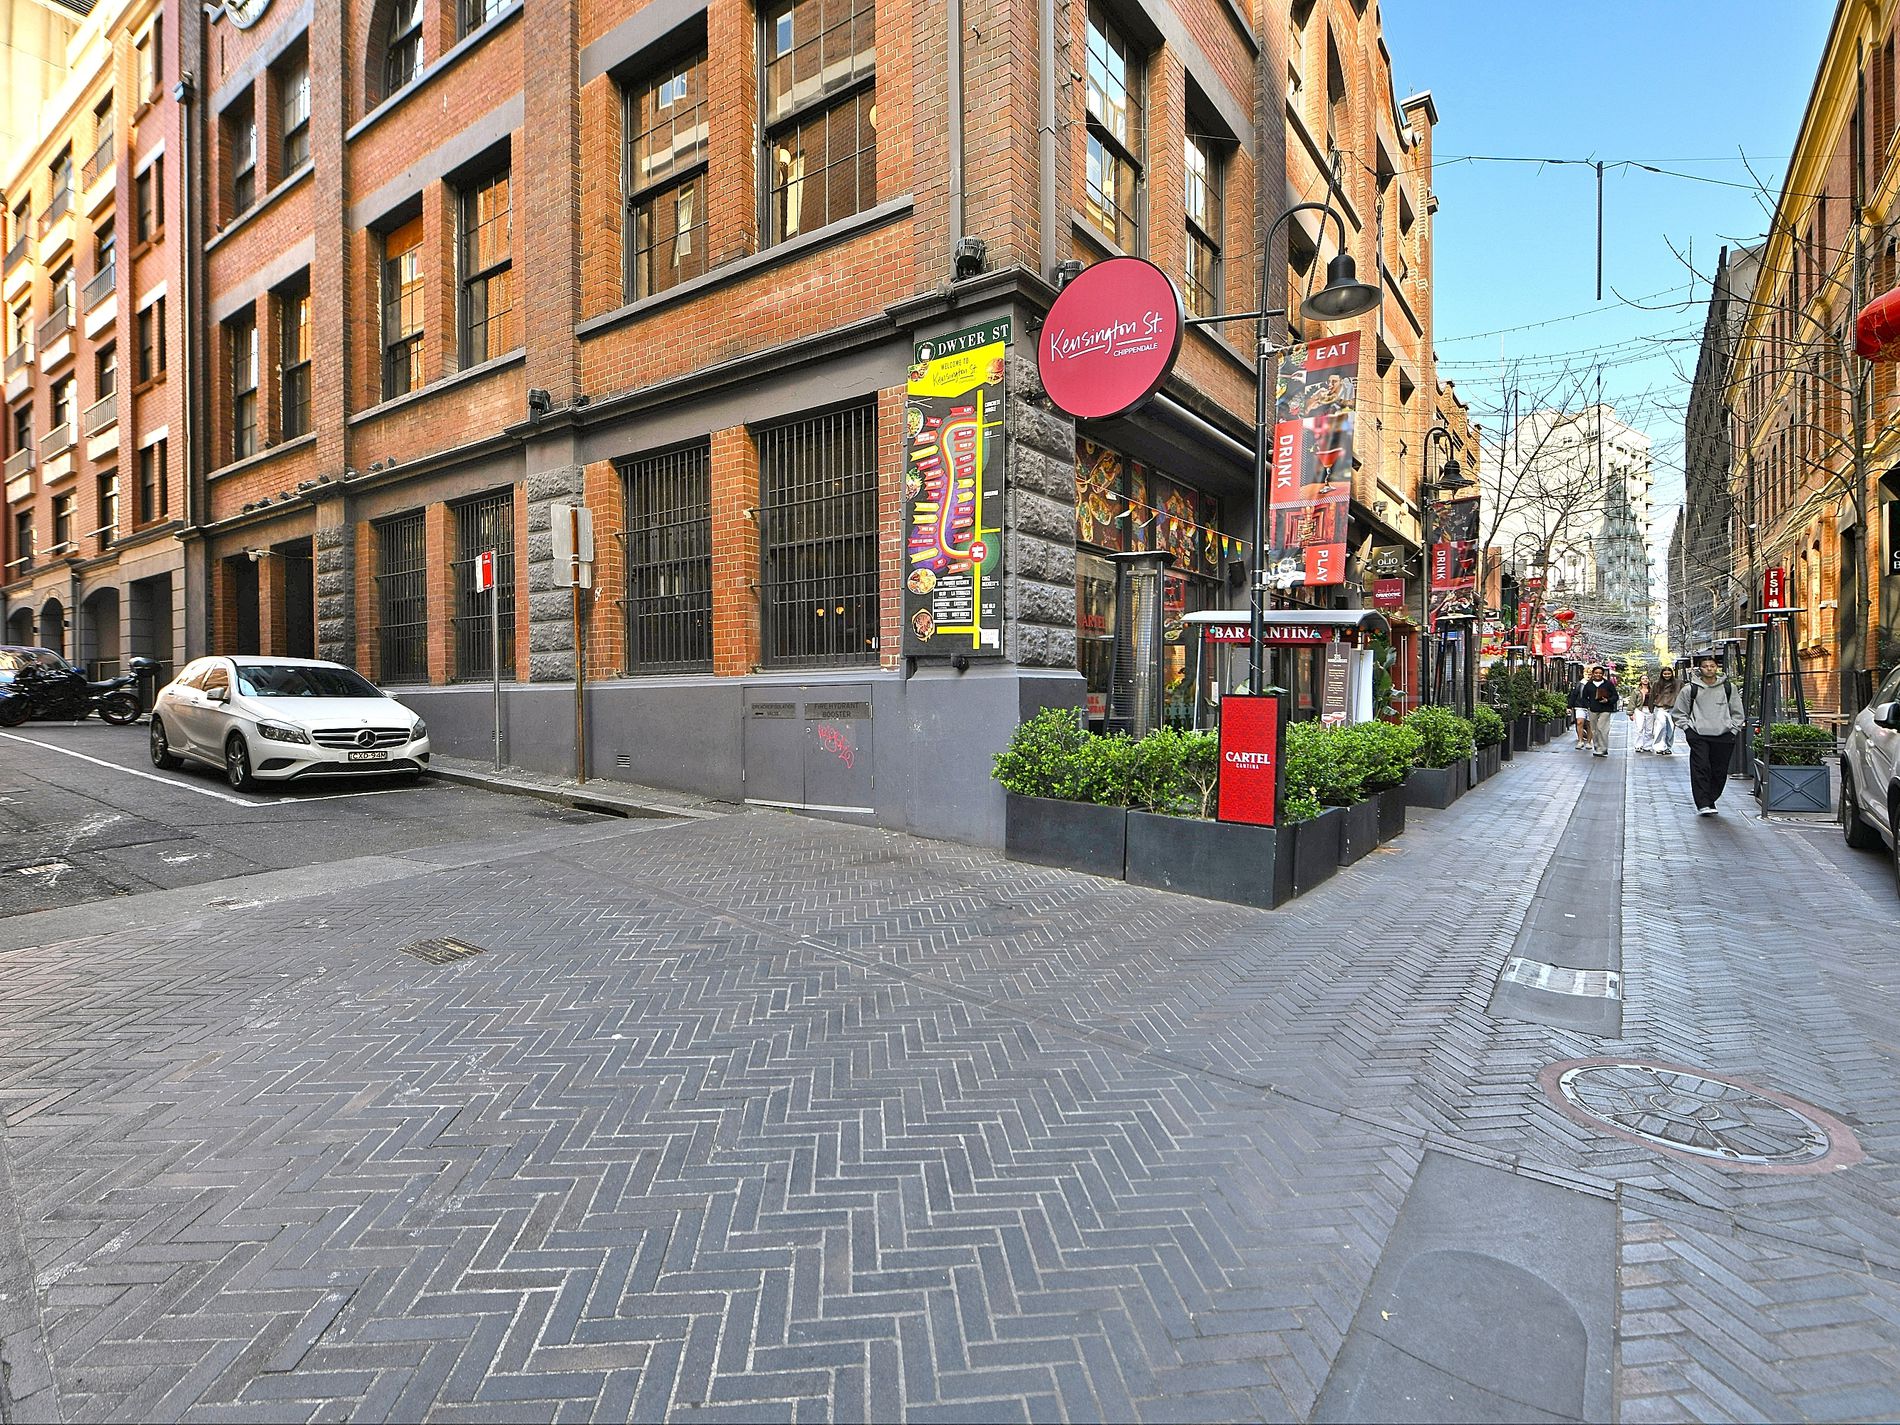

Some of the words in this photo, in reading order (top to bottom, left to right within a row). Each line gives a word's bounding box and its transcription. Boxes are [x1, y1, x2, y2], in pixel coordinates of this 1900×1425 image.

[938, 331, 986, 356] DWYER
[992, 323, 1009, 340] ST
[1050, 319, 1137, 362] Kensington
[1143, 311, 1164, 335] St.
[1113, 342, 1159, 357] CHIPPENDALE
[1316, 342, 1350, 360] EAT
[941, 358, 962, 371] WELCOME
[1277, 434, 1294, 489] DRINK
[1316, 549, 1329, 582] PLAY
[1377, 557, 1398, 566] OLIO
[1436, 550, 1446, 580] DRINK
[1214, 626, 1245, 639] BAR
[1248, 626, 1322, 639] NTINA
[814, 702, 828, 710] FIRE
[829, 702, 859, 710] HYDRANT
[1225, 751, 1270, 765] CARTEL
